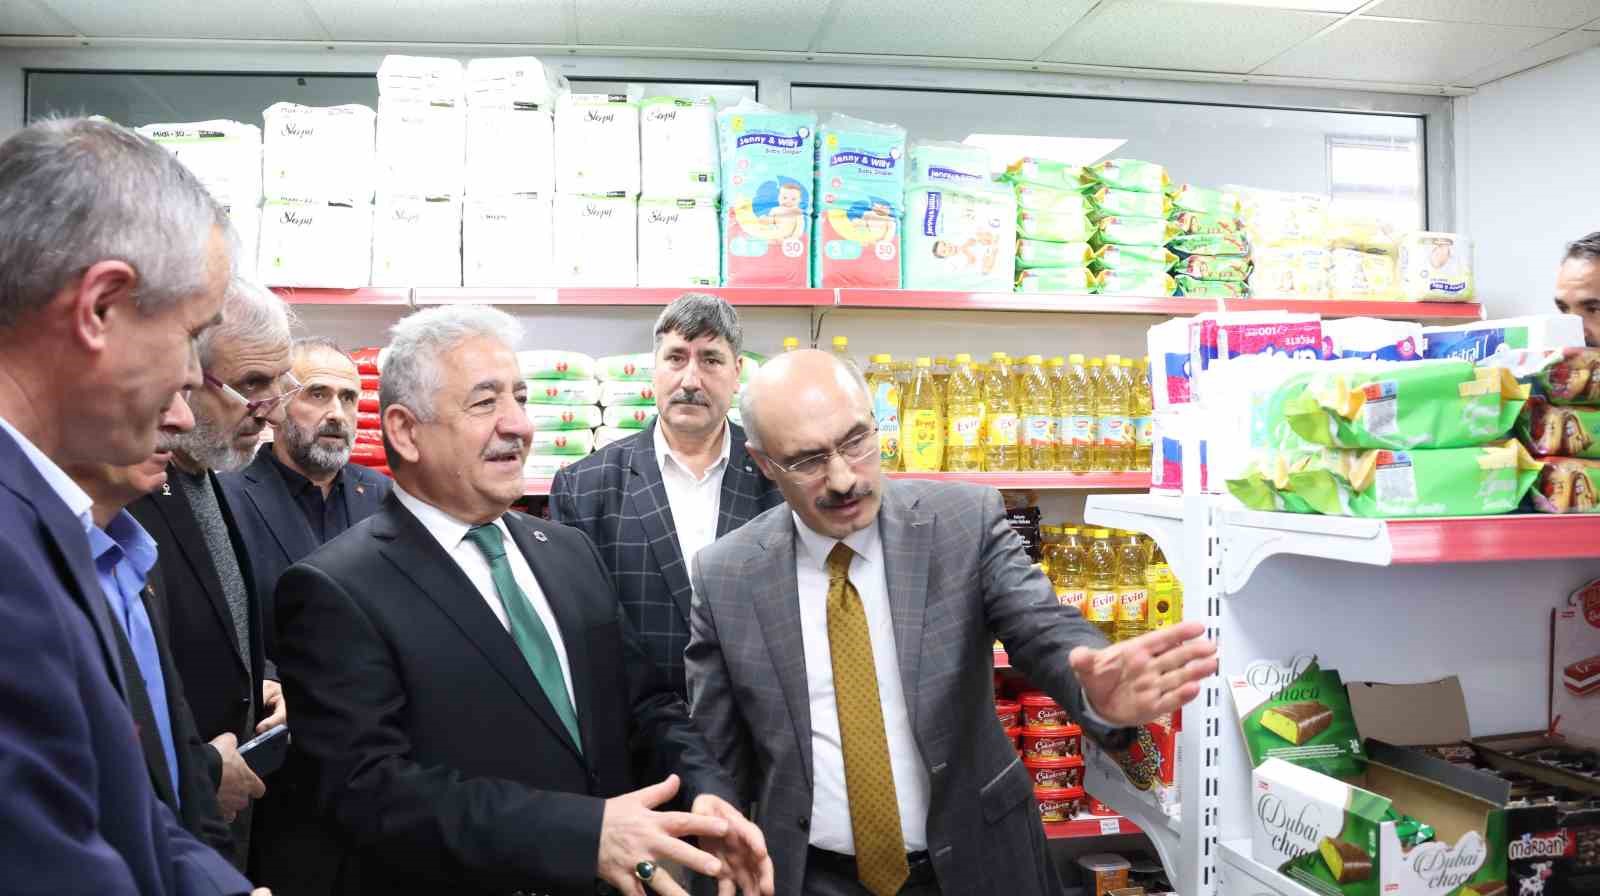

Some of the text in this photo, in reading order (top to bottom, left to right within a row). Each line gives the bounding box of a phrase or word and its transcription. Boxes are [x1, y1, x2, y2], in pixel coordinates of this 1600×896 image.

[785, 241, 800, 253] 50
[879, 244, 893, 255] 50
[1092, 595, 1114, 608] Evin
[1120, 592, 1144, 605] Evin
[1258, 793, 1321, 842] Dubai
[1413, 849, 1478, 880] Dubai
